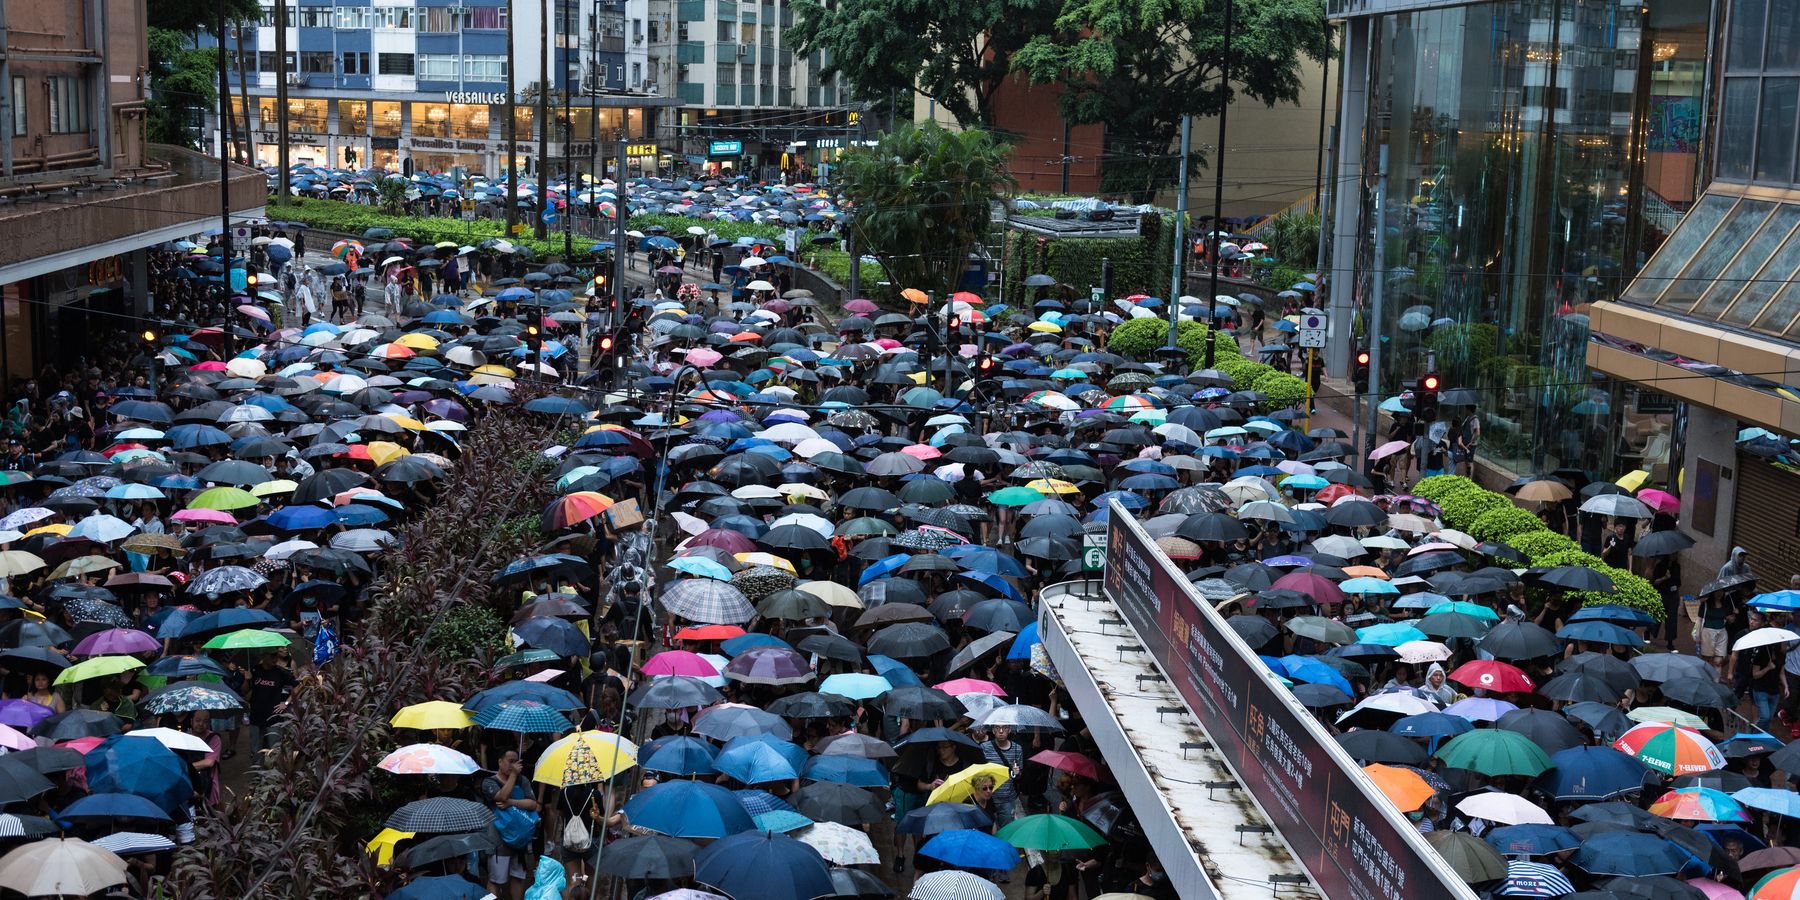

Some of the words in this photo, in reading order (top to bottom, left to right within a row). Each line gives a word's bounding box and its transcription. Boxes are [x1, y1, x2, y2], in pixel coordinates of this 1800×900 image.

[445, 91, 506, 105] VERSAILLES
[410, 138, 453, 149] Versailles
[456, 140, 486, 153] Lamps
[1249, 704, 1264, 743] 旺角
[1330, 800, 1350, 848] 屯門
[1352, 815, 1405, 890] 新界屯門屯盛街1號
